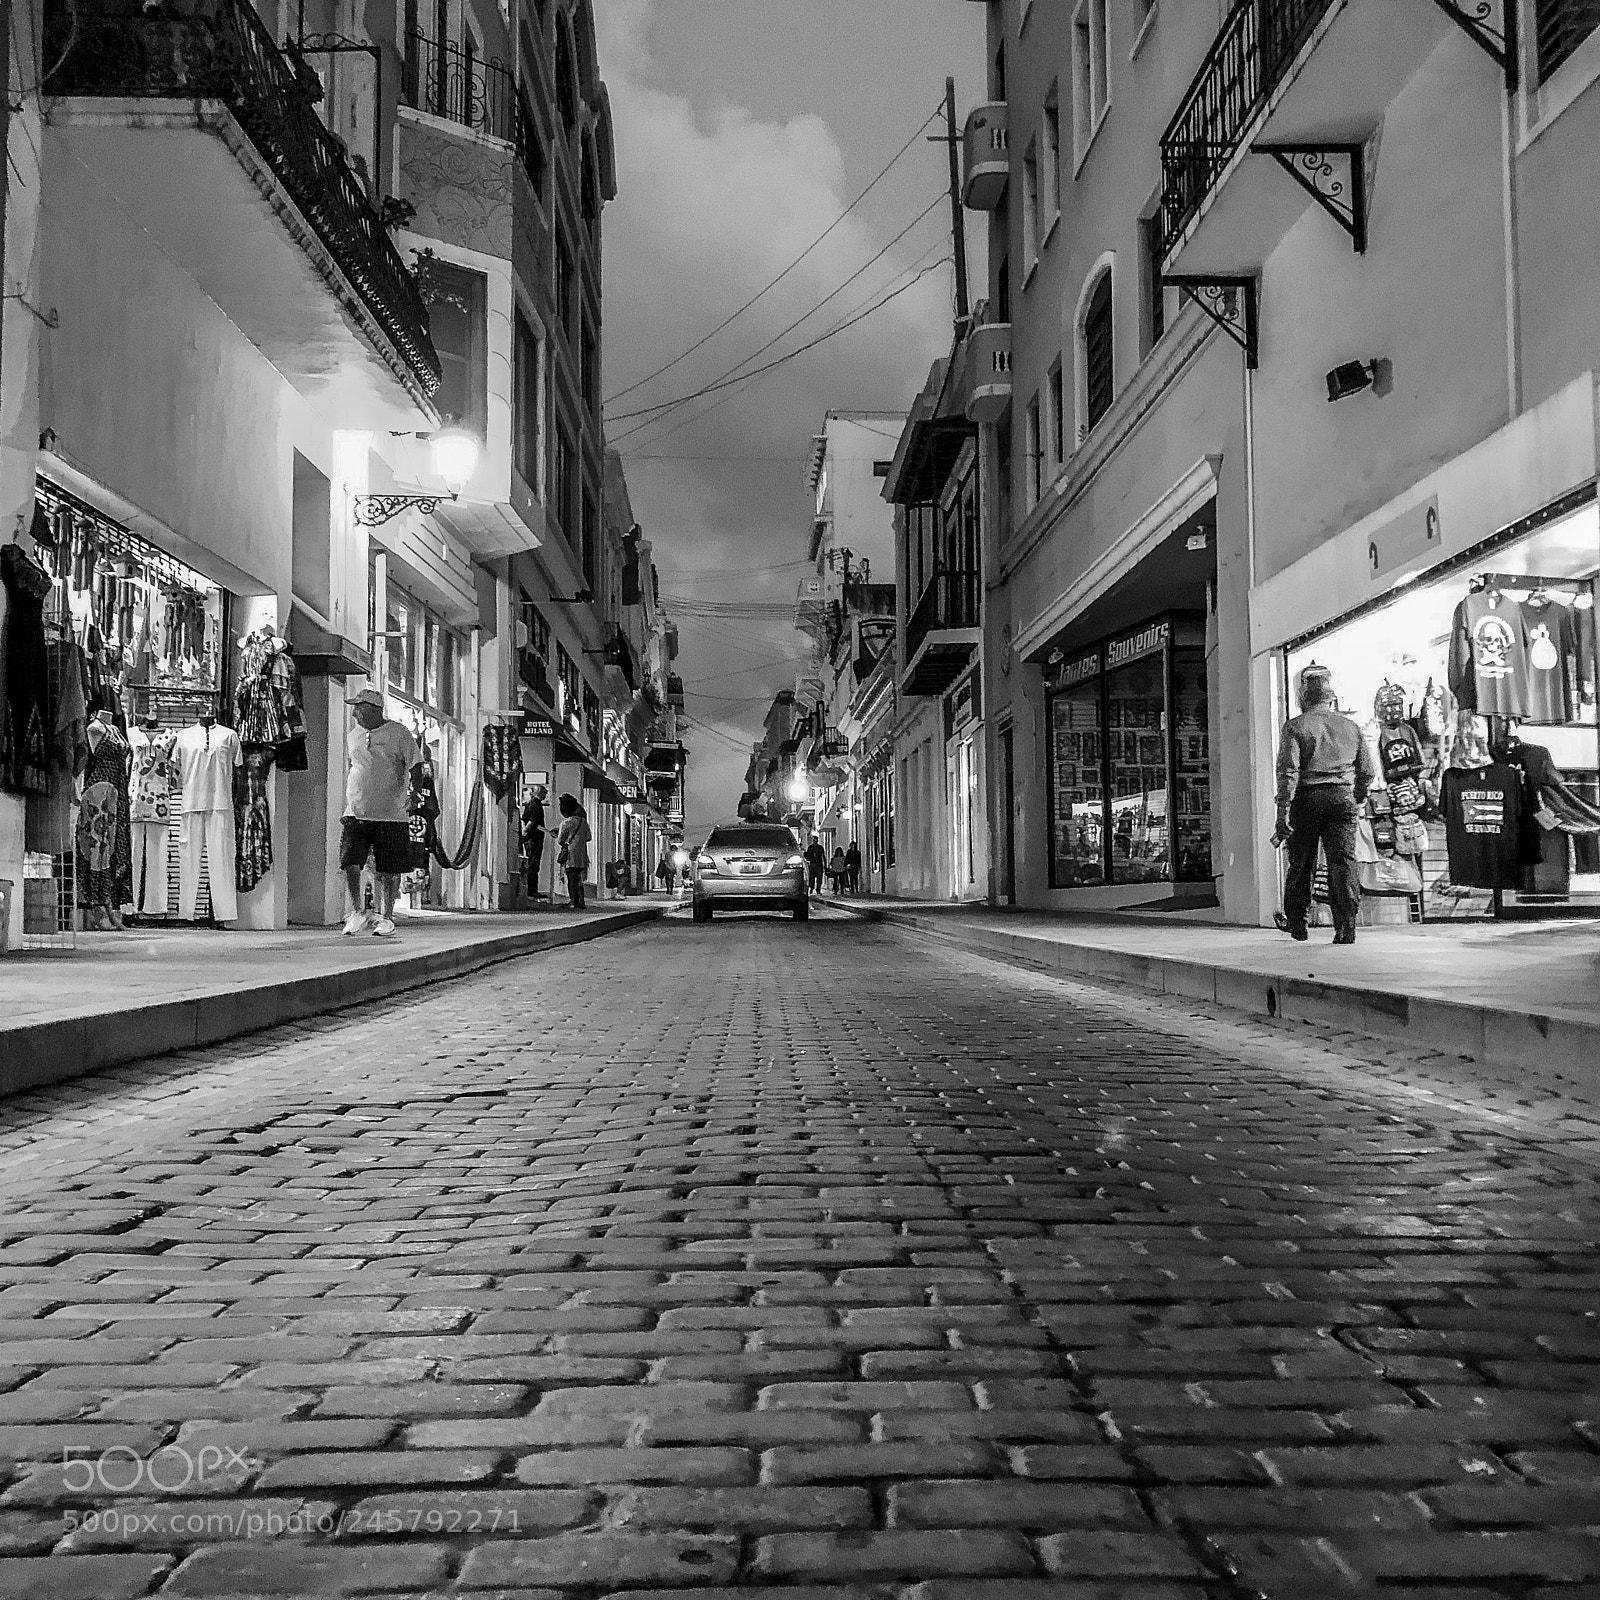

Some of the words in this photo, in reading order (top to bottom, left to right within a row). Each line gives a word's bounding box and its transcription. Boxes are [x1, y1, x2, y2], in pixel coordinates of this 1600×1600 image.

[1055, 654, 1098, 687] James
[1108, 622, 1169, 664] Souvenirs
[524, 727, 553, 735] MILANO
[1486, 790, 1504, 800] RICO
